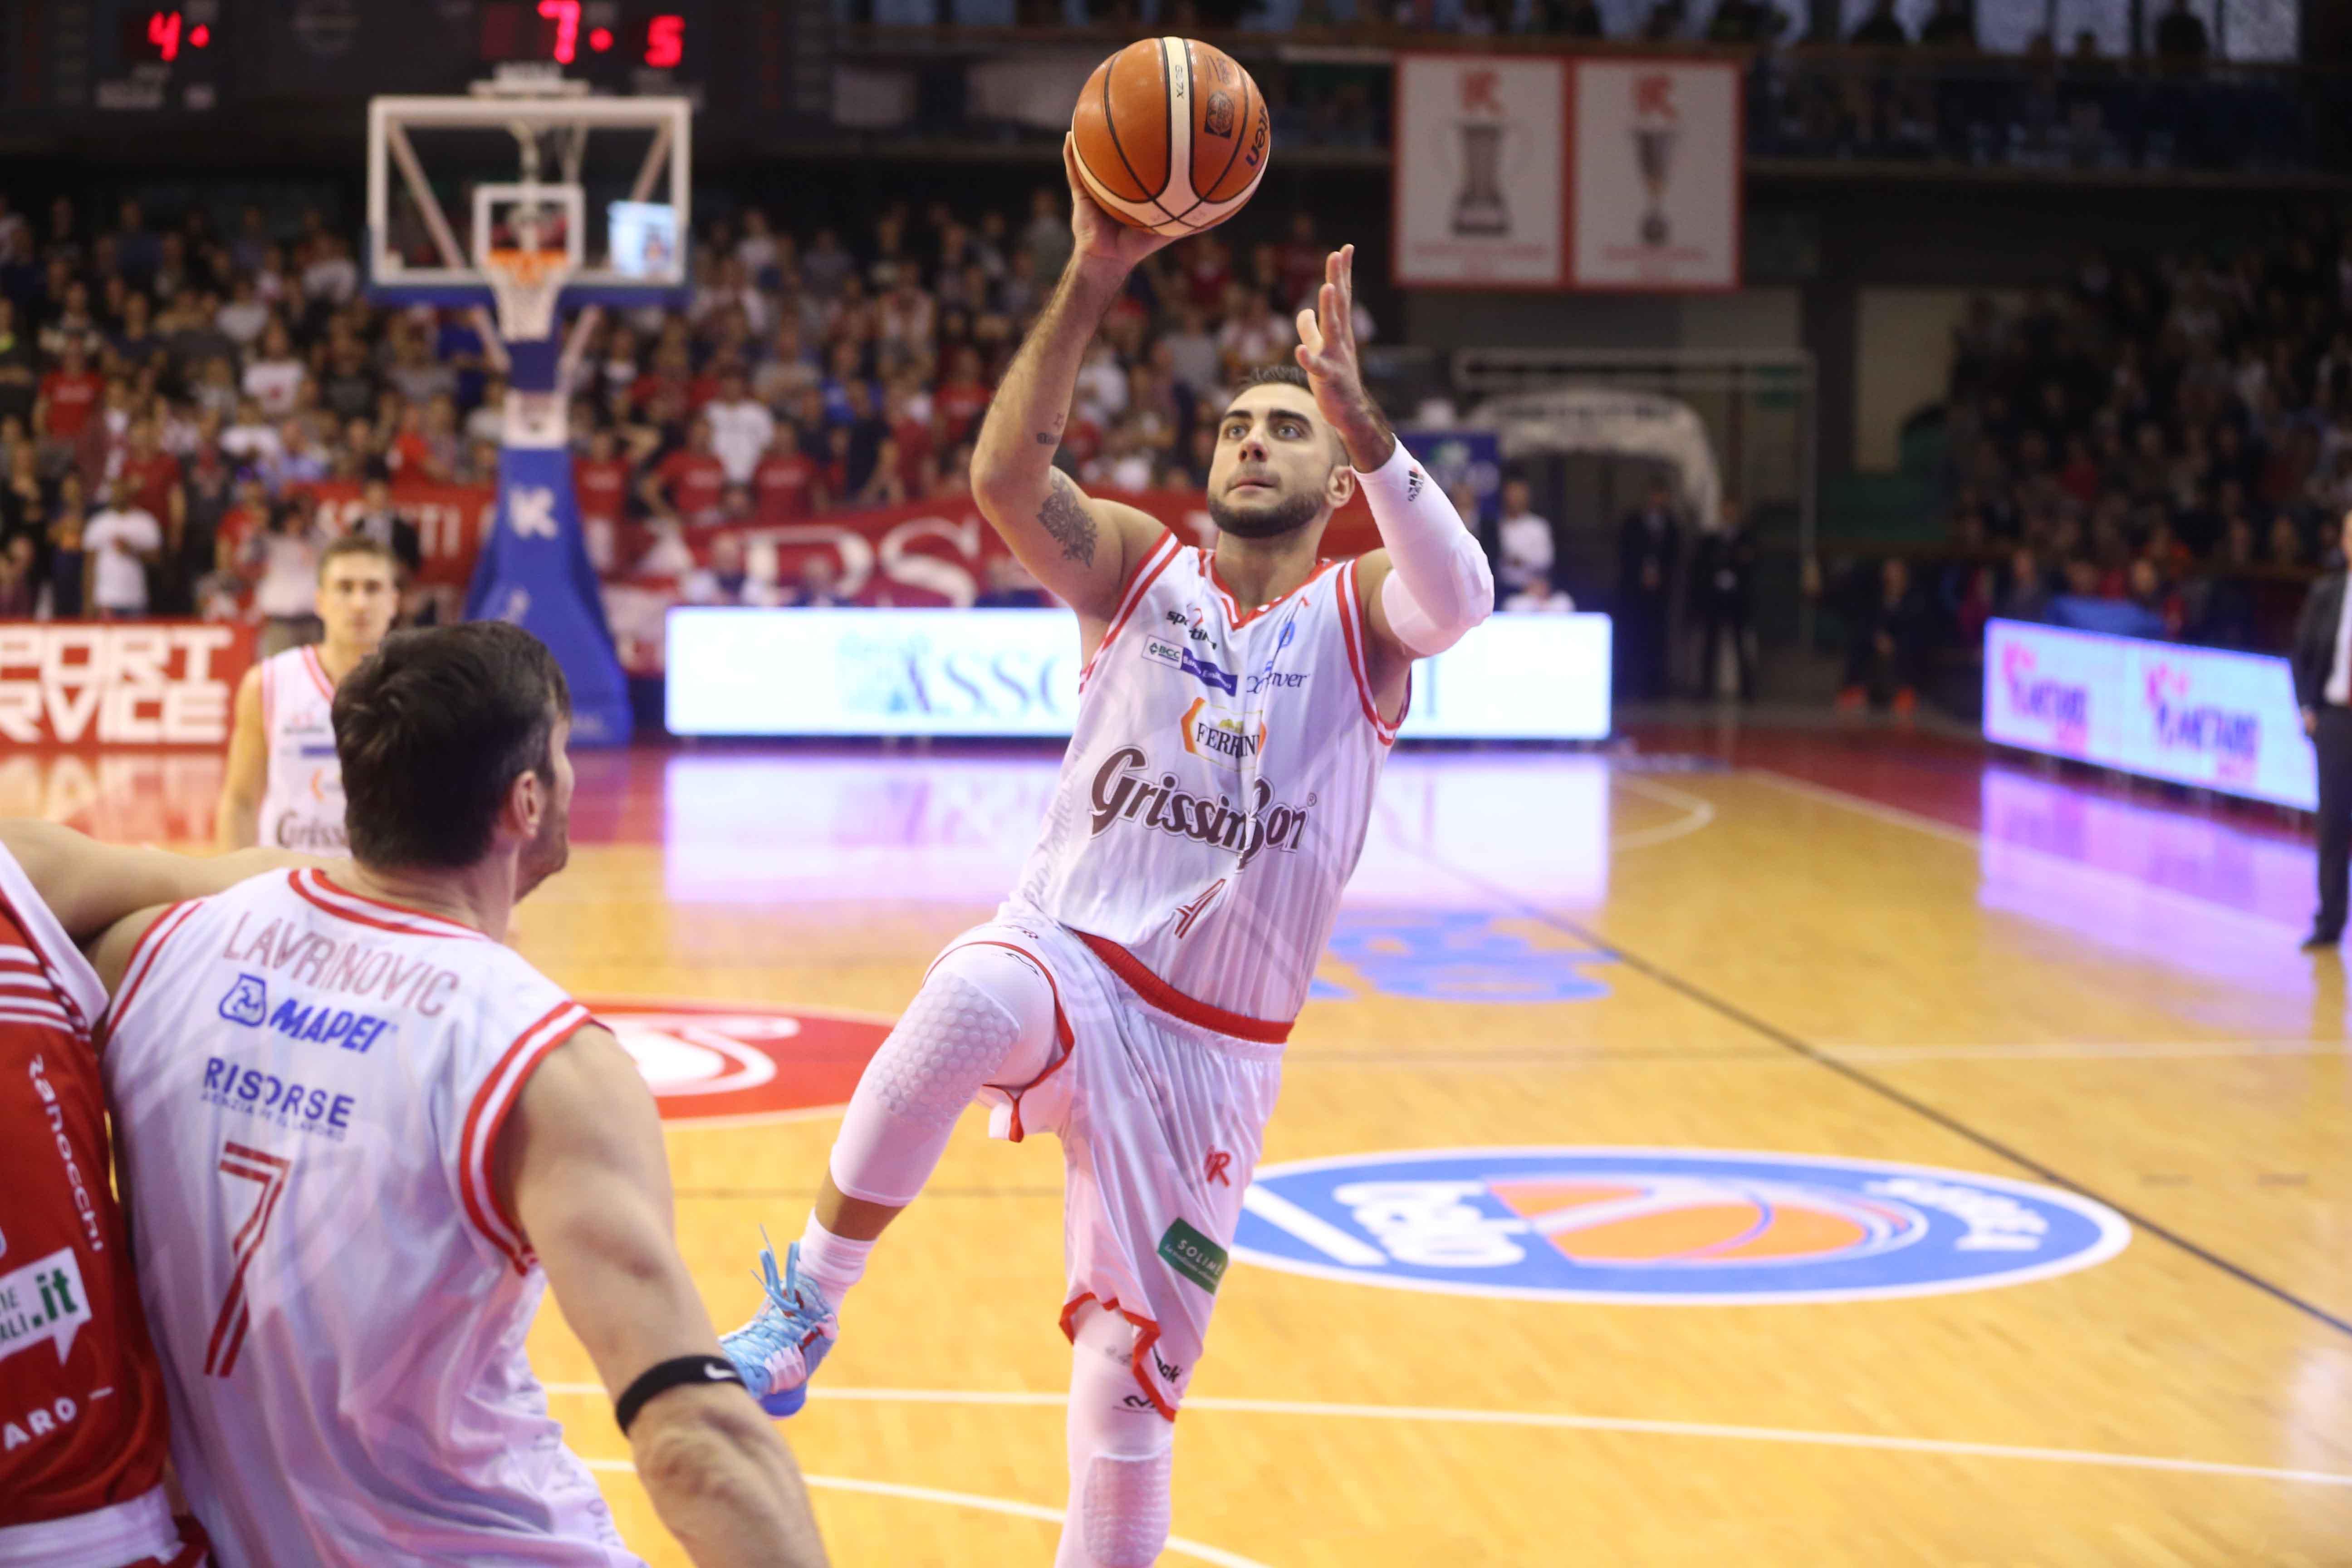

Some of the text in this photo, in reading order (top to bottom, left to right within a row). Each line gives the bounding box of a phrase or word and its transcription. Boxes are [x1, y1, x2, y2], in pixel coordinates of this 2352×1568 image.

[1159, 645, 1181, 660] BCC
[222, 912, 460, 1017] LAVRINOVIC
[269, 998, 387, 1054] MAPEI
[204, 1139, 291, 1377] 7
[4, 1396, 77, 1450] ARO
